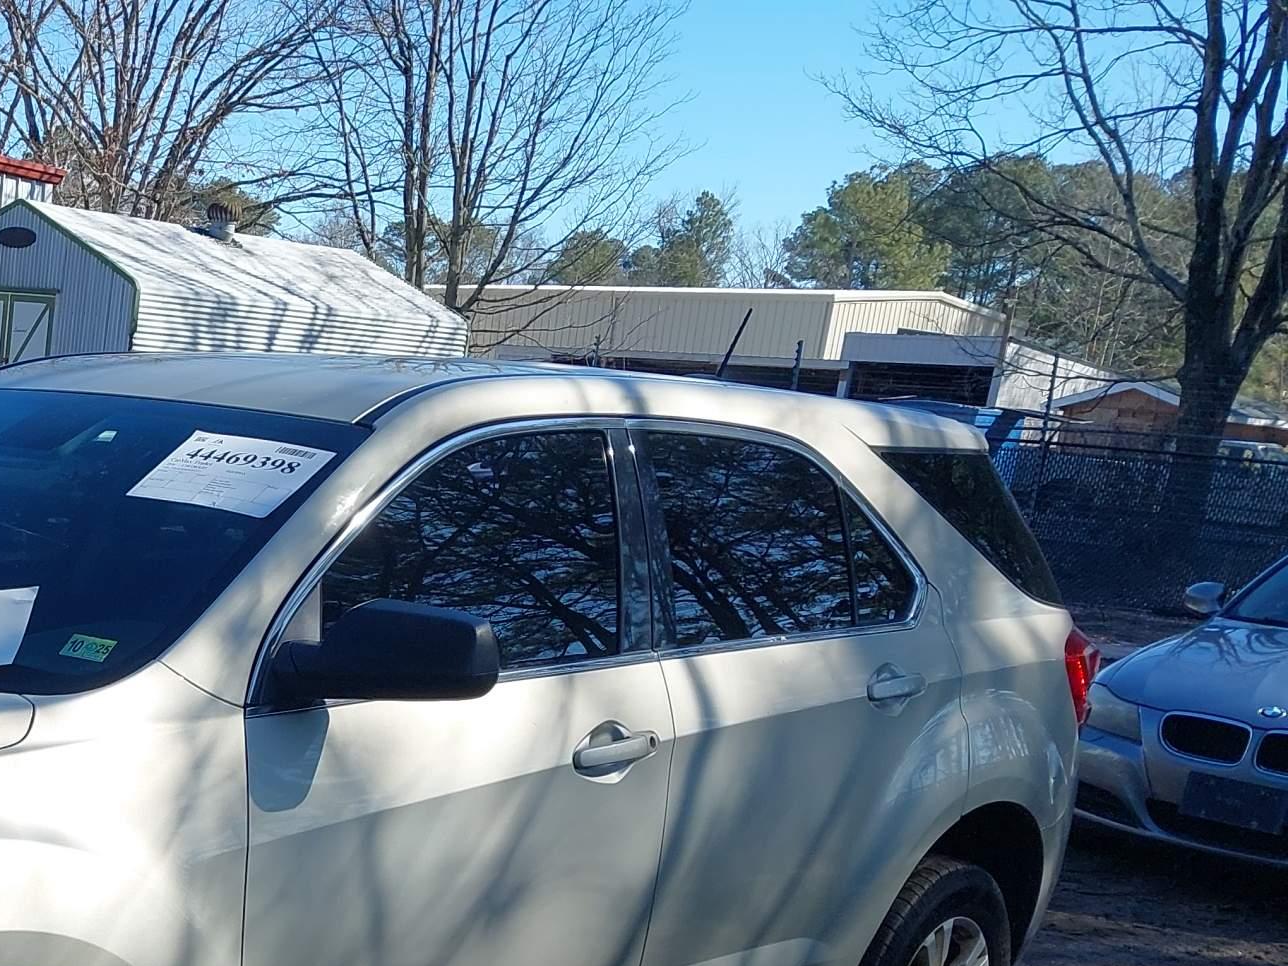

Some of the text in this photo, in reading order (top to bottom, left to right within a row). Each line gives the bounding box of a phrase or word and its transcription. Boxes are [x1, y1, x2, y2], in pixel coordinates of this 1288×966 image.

[186, 447, 302, 475] 44469398
[67, 639, 112, 654] 10 25
